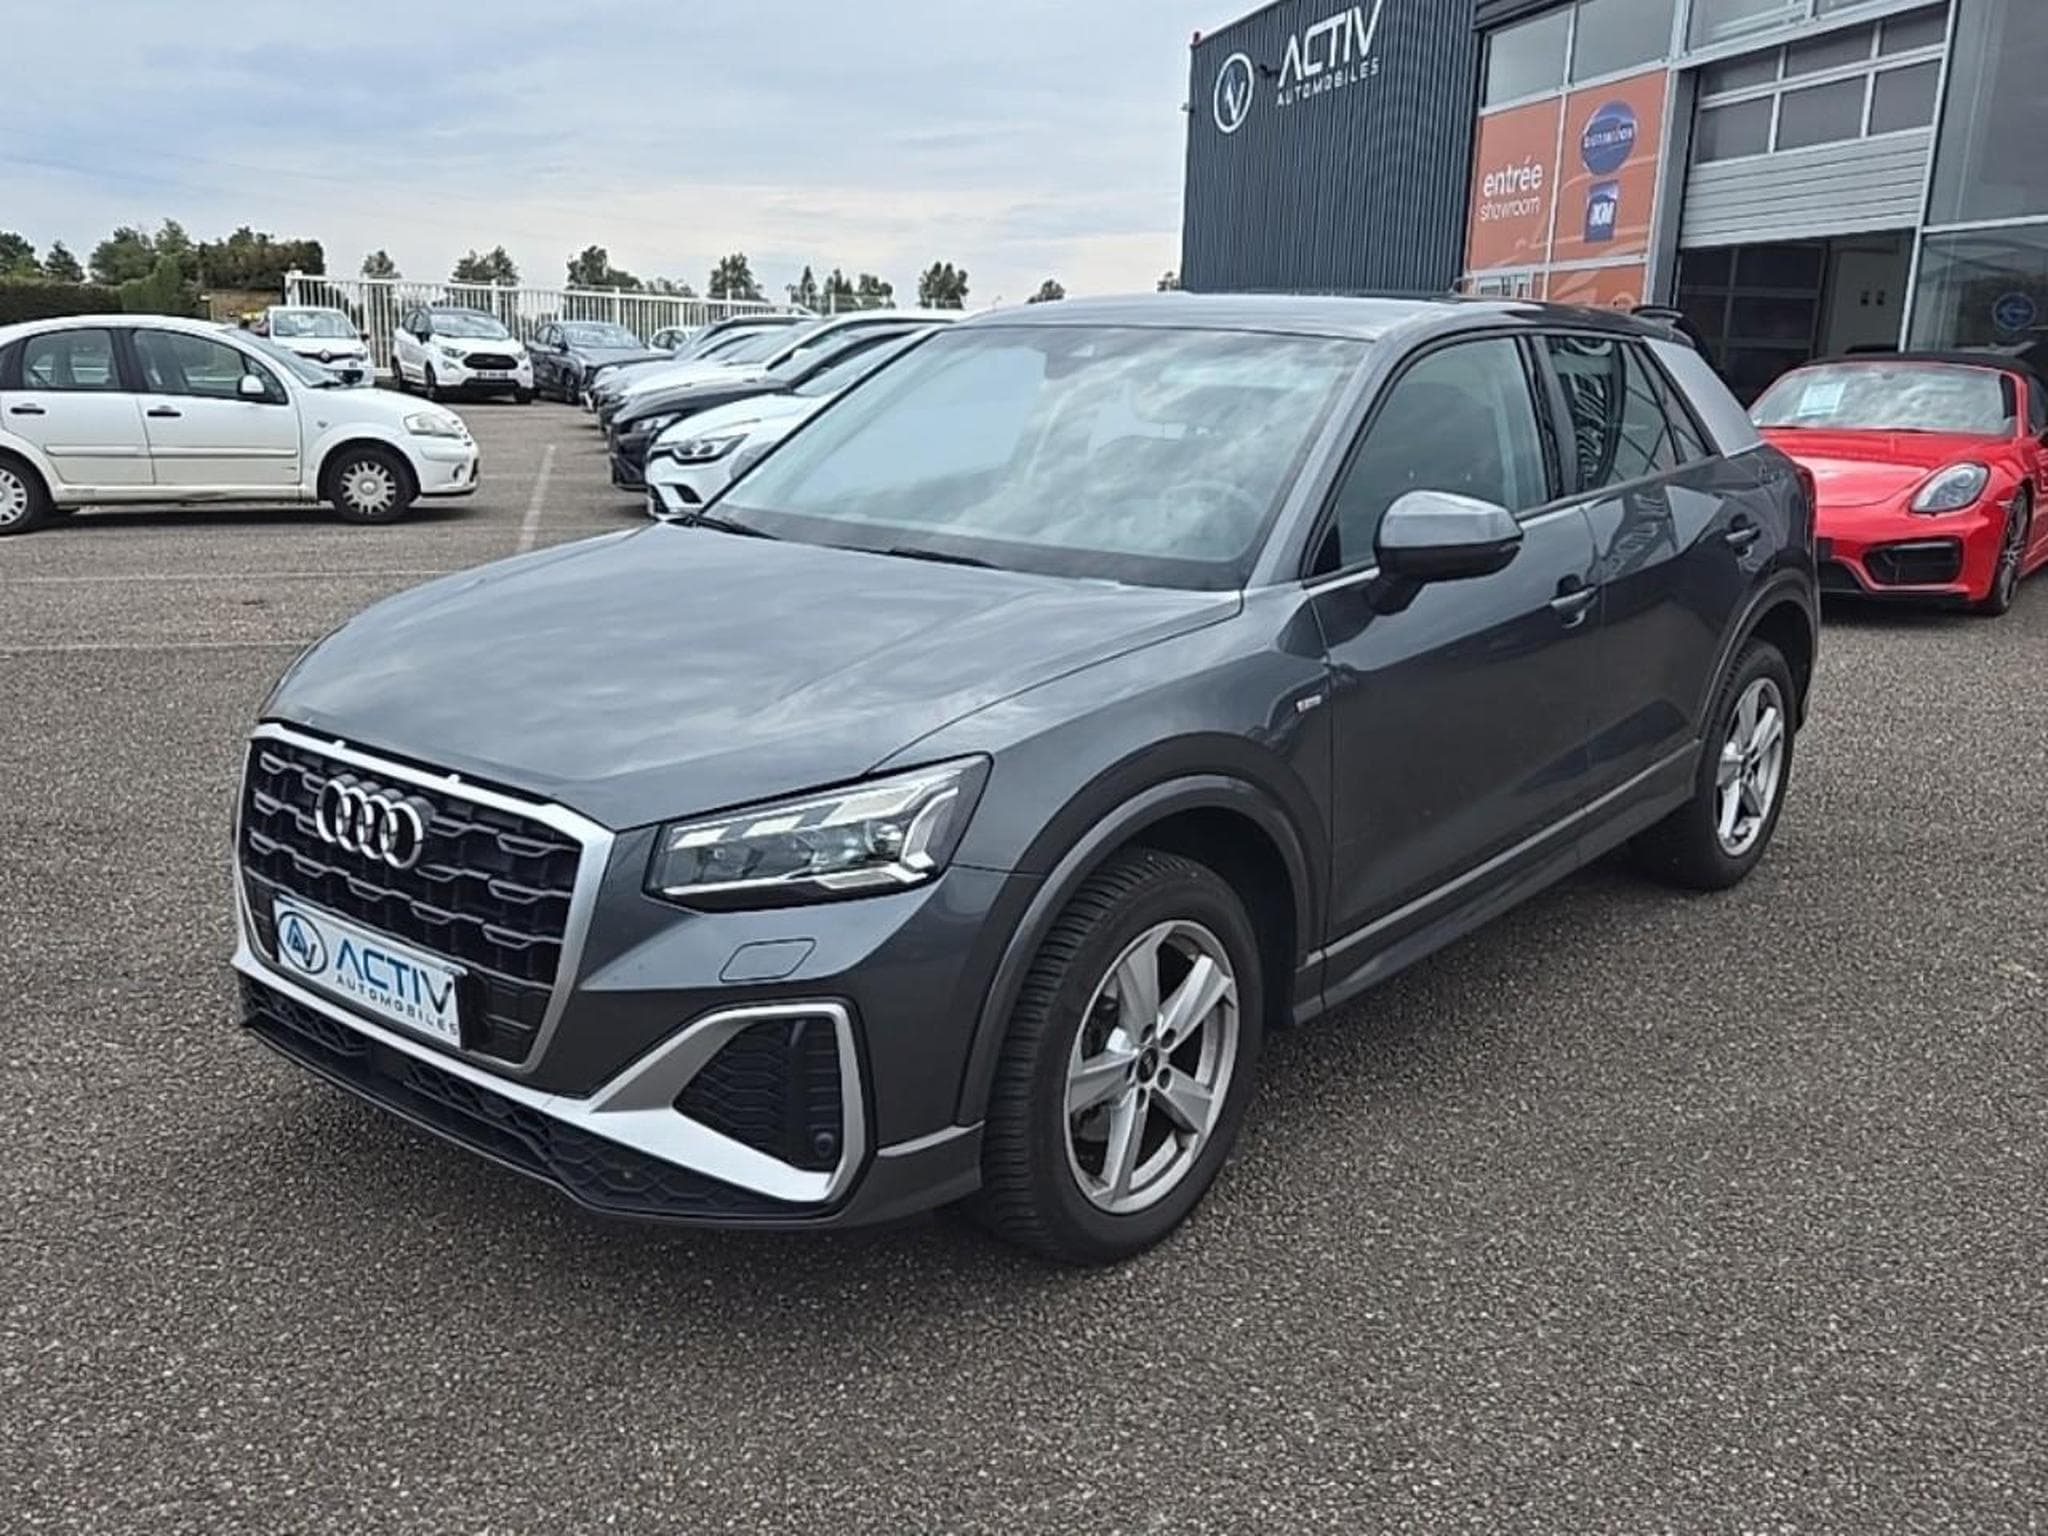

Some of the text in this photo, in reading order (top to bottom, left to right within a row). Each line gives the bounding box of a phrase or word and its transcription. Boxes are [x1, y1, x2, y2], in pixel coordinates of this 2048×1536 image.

[1278, 0, 1382, 88] ACTIV
[1277, 57, 1380, 106] AUTOMOBILES
[1483, 155, 1544, 197] entrée
[1480, 196, 1541, 222] showroom
[336, 938, 453, 1015] ACTIV
[335, 975, 459, 1037] AUTOMOBILES
